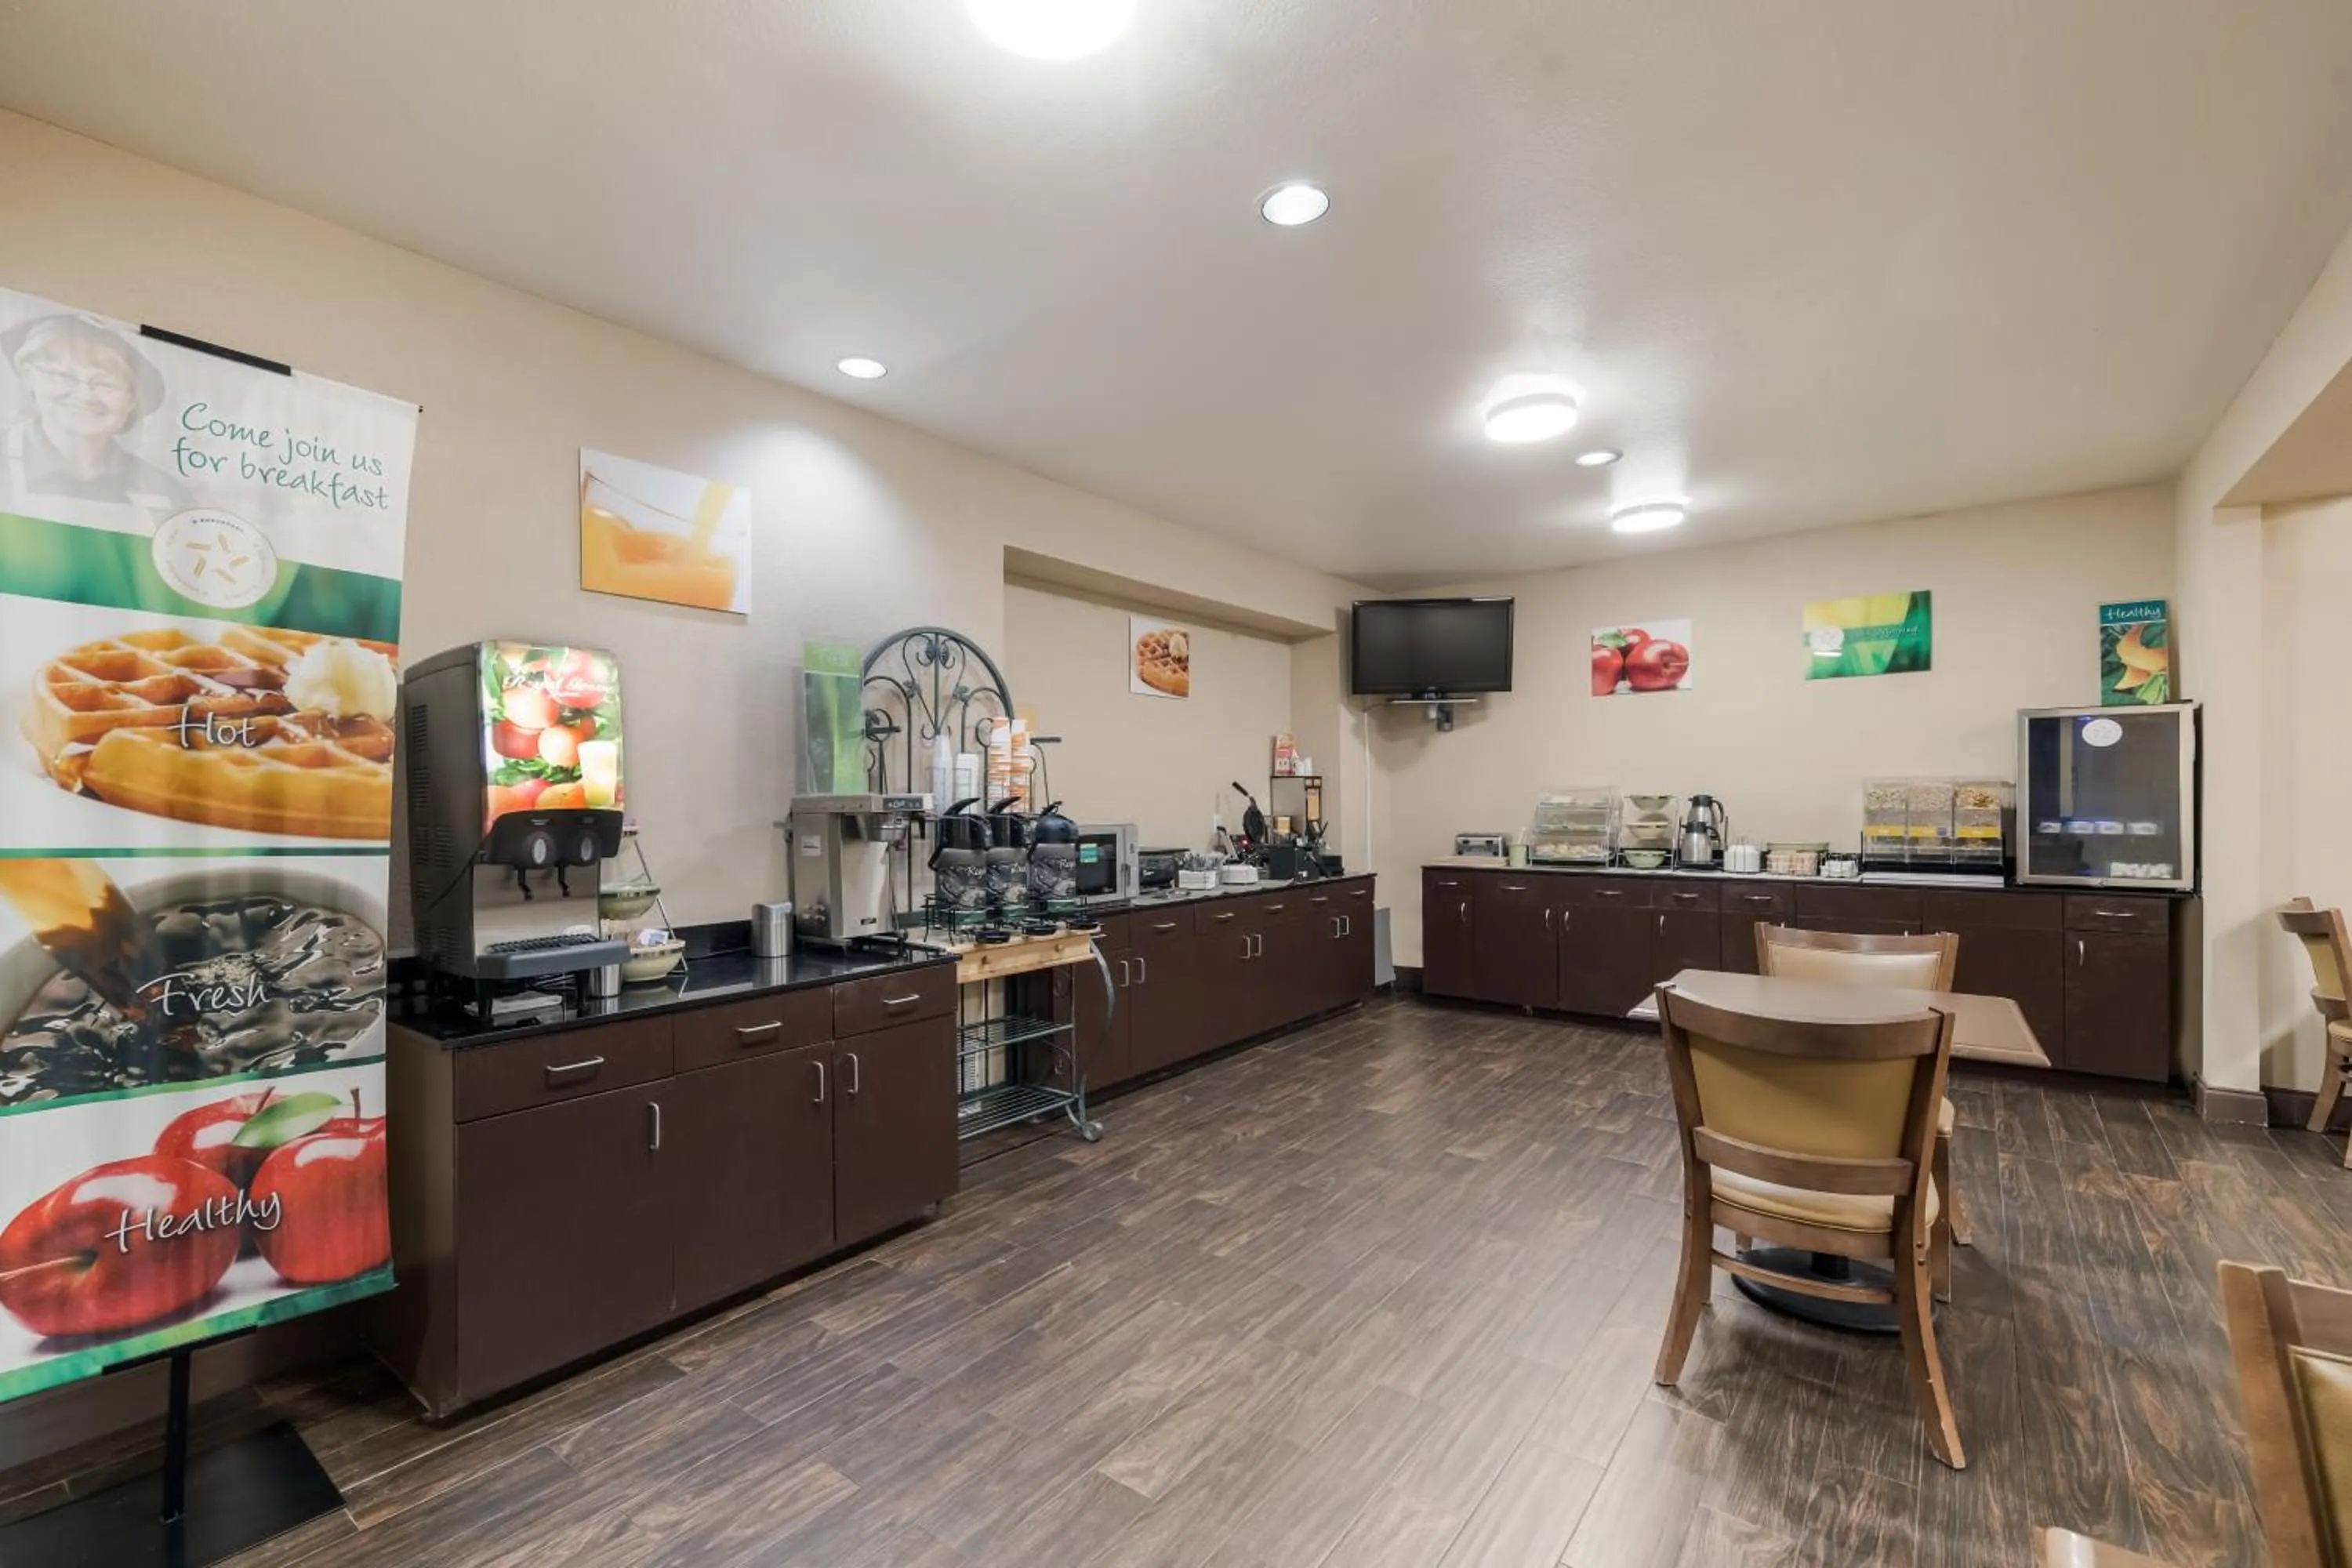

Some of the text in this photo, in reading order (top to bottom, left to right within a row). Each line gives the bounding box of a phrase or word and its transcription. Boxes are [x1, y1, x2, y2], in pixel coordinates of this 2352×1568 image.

[181, 402, 383, 477] Come join us
[172, 436, 389, 510] for breakfast
[2104, 605, 2161, 621] Healthy
[165, 705, 256, 747] Hot
[136, 972, 271, 1015] Fresh
[104, 1189, 281, 1253] Healthy
